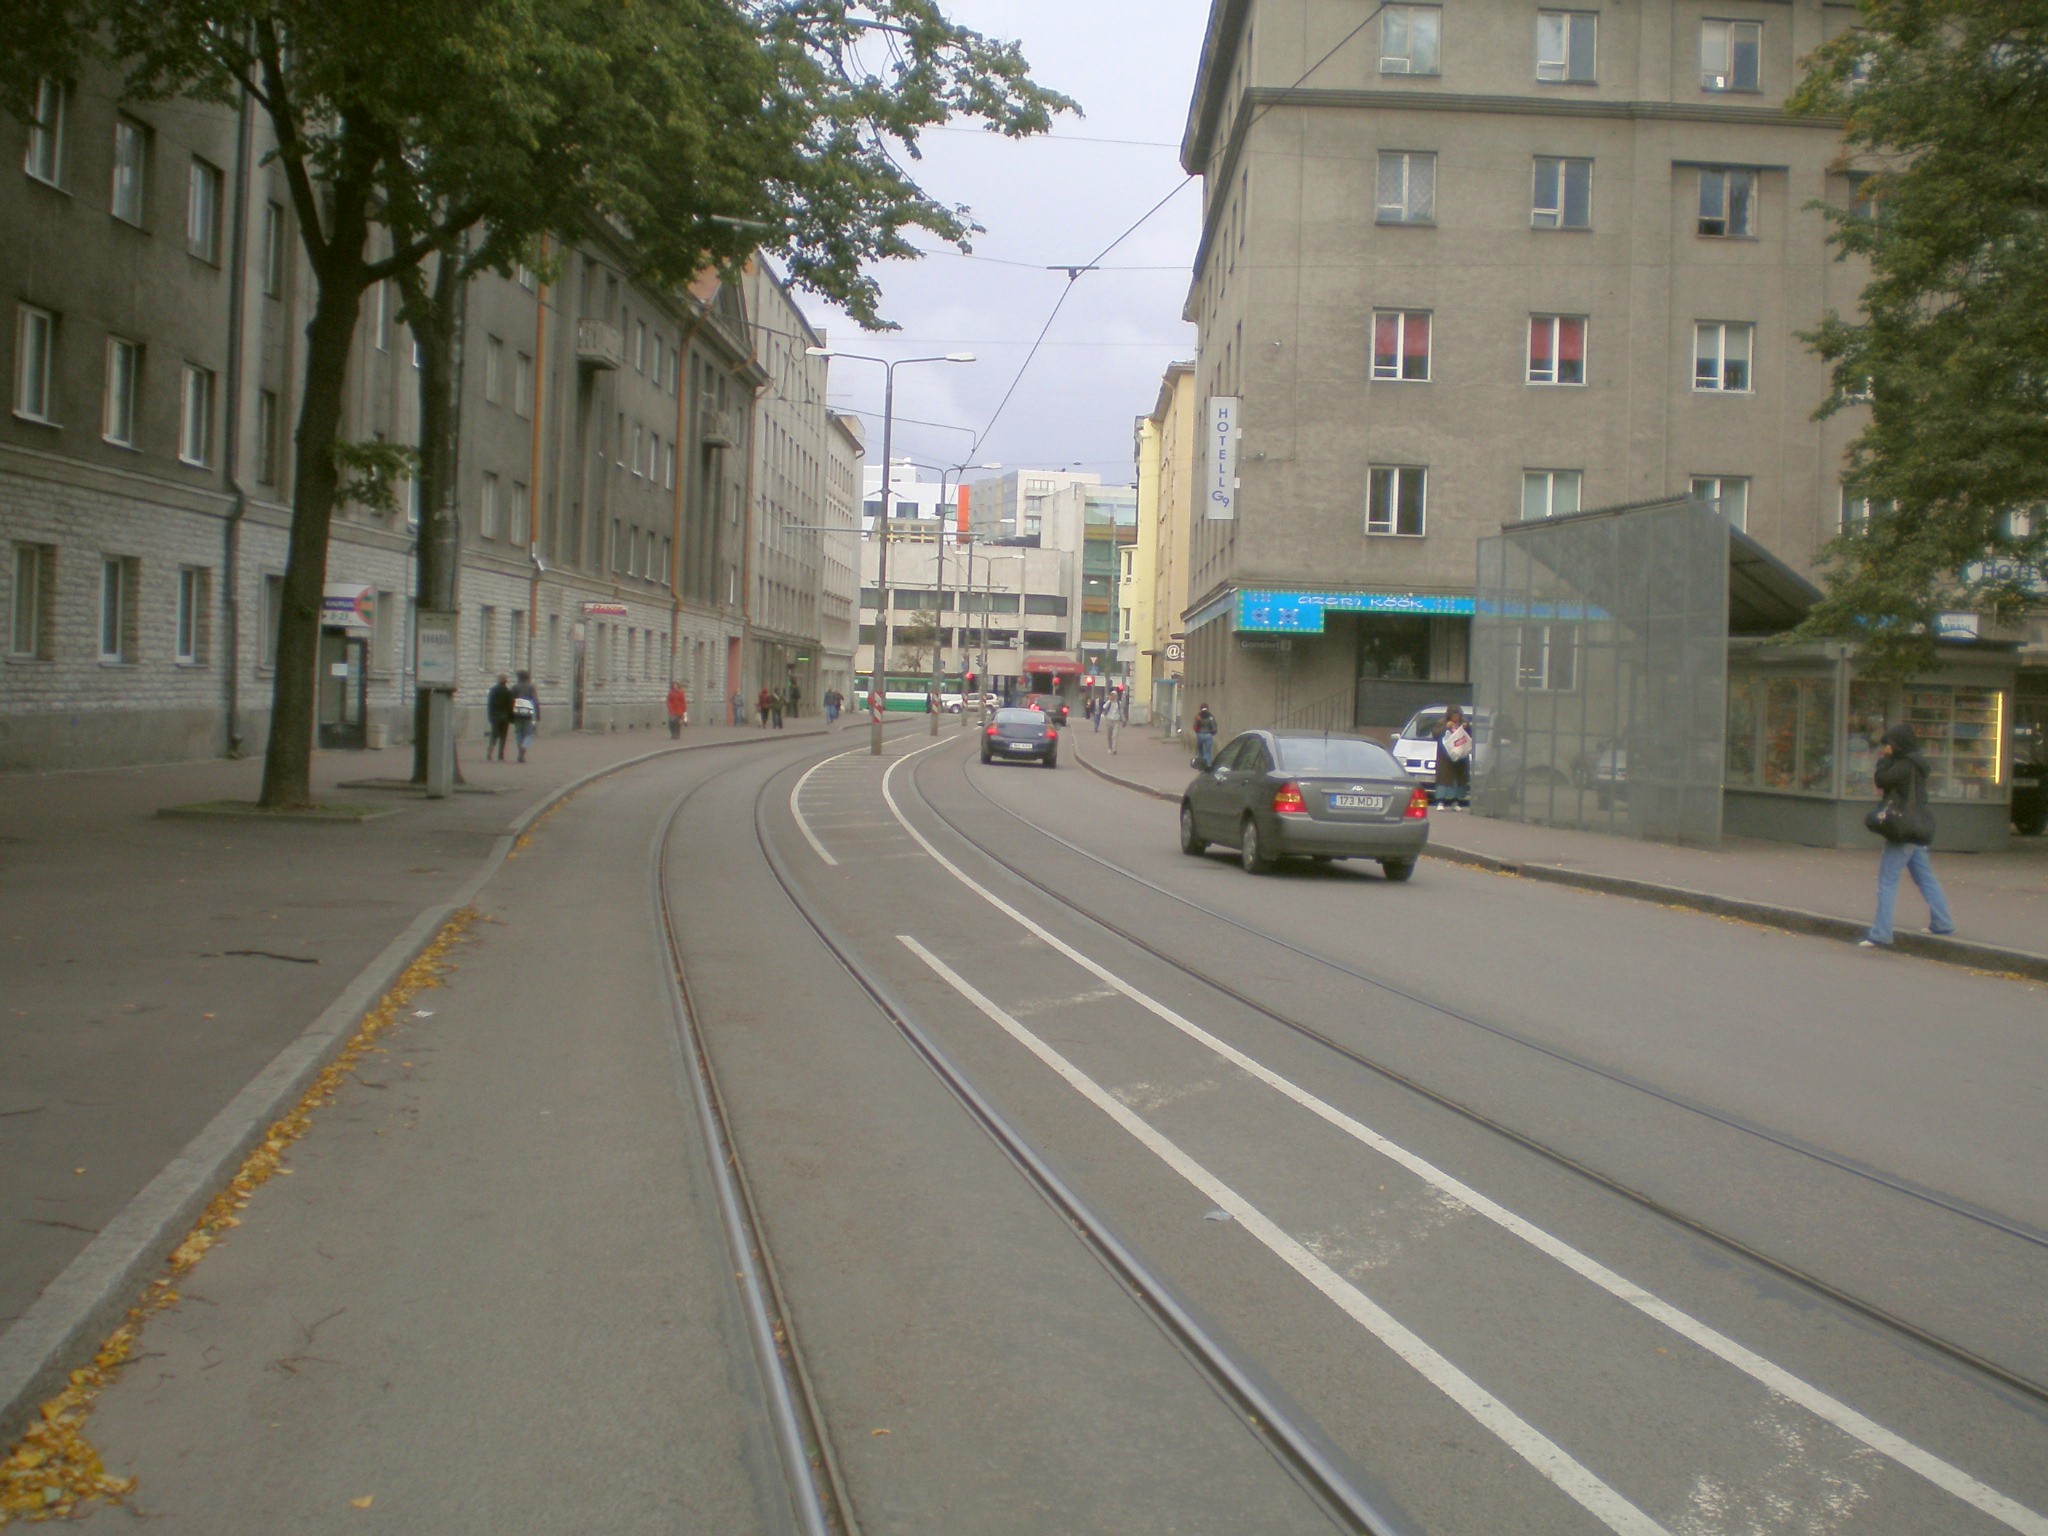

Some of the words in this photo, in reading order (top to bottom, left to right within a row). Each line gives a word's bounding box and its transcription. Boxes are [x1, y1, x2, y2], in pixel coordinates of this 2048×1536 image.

[1216, 407, 1230, 488] HOTELL
[1211, 490, 1230, 508] G9
[1339, 795, 1355, 805] 173
[1357, 796, 1380, 807] MDJ
